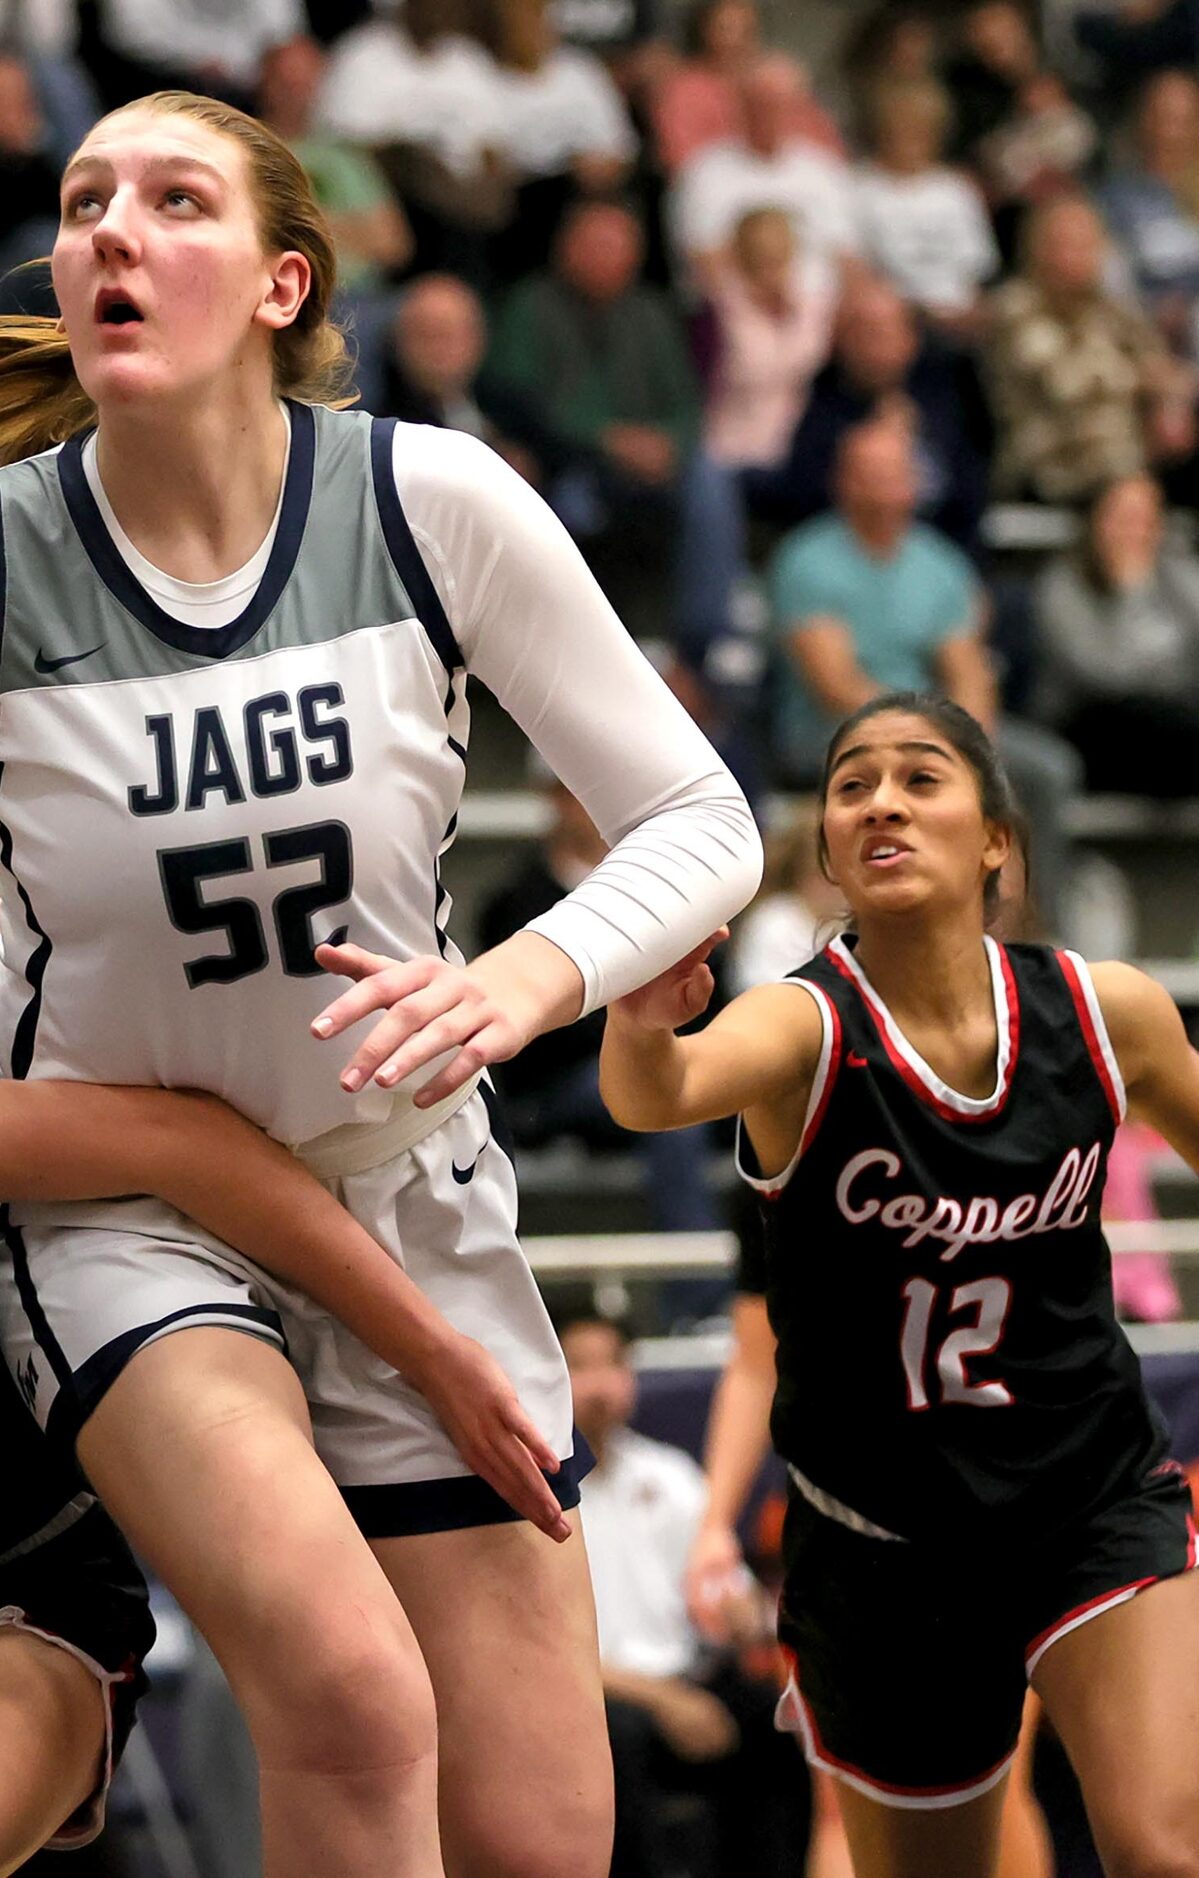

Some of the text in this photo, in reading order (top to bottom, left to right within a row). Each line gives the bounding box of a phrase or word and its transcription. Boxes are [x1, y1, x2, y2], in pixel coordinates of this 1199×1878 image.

[128, 681, 354, 817] JAGS
[156, 819, 354, 990] 52
[835, 1142, 1101, 1262] Coppell
[902, 1277, 1015, 1411] 12
